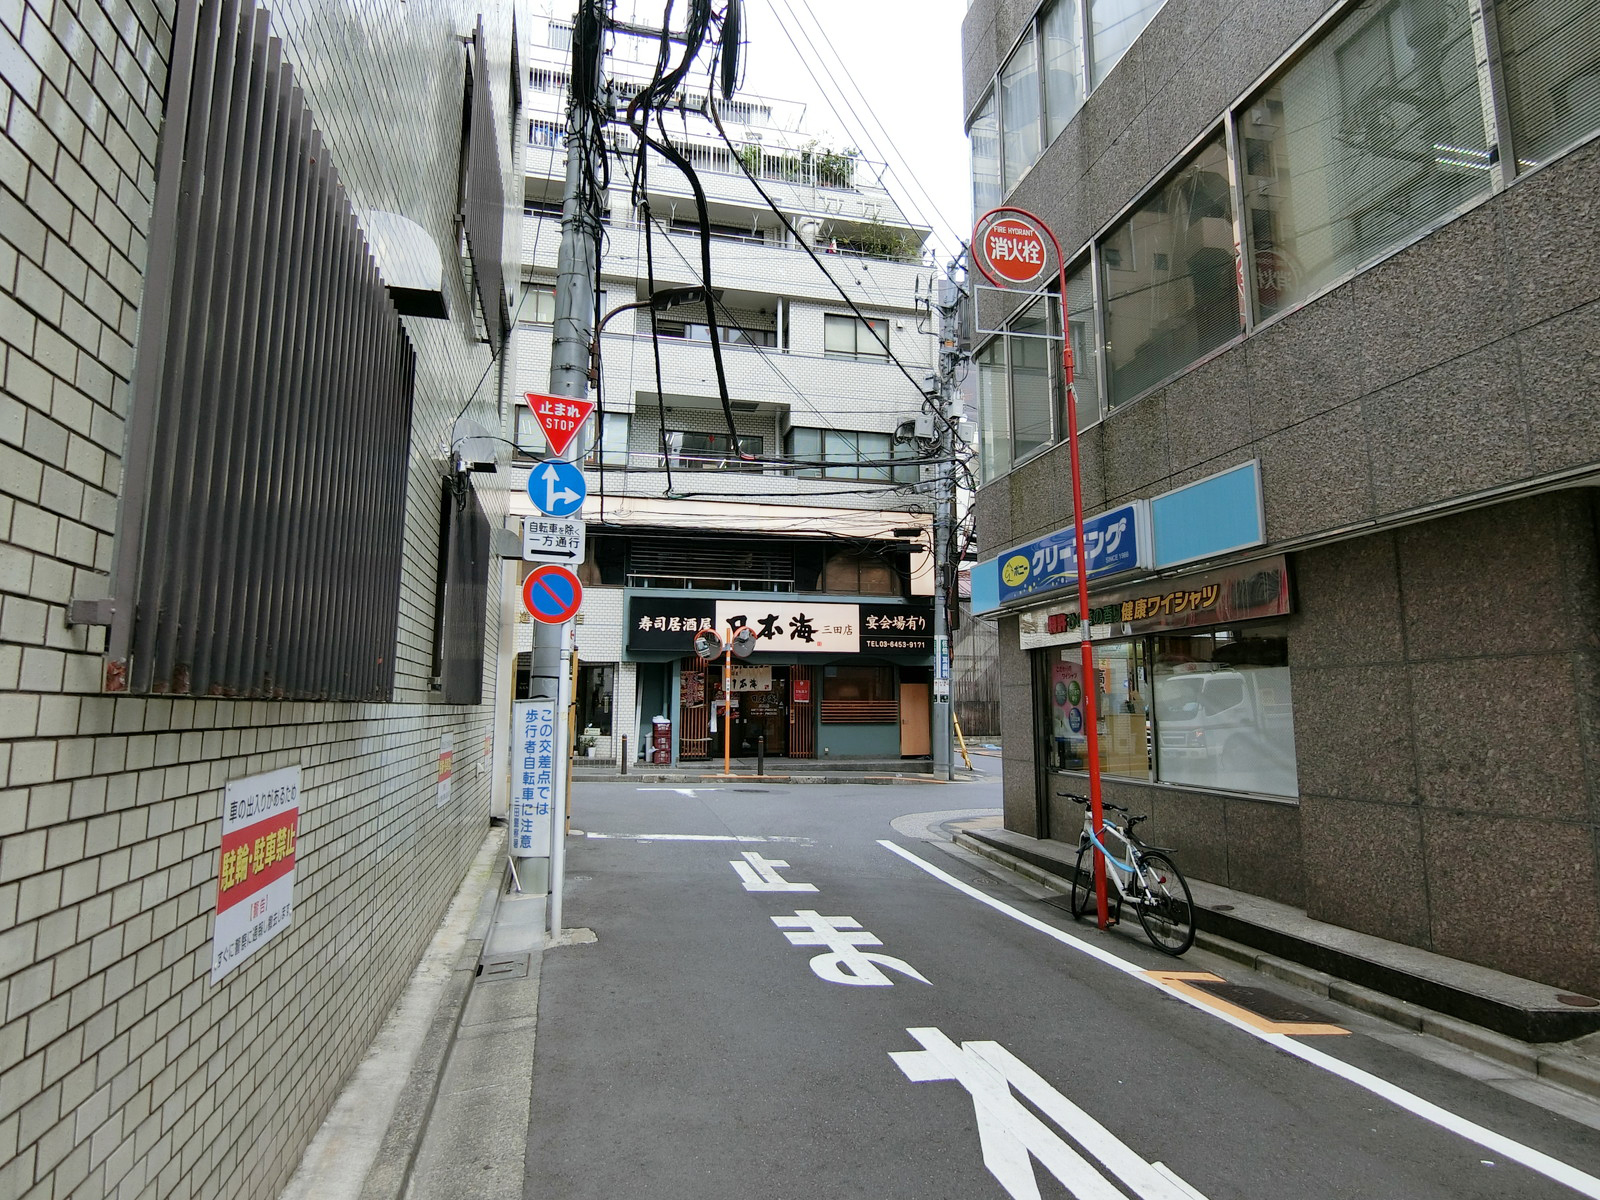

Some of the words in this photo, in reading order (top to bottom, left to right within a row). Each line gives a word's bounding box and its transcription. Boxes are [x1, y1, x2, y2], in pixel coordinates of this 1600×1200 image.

[993, 226, 1006, 234] FIRE
[1008, 227, 1033, 237] HYDRANT
[990, 236, 1041, 264] 消火栓
[539, 401, 580, 418] 止まれ
[546, 418, 575, 431] STOP
[529, 521, 580, 536] 自転車を除く
[529, 535, 580, 549] 一方通行
[1031, 517, 1127, 576] クリーニング
[638, 615, 712, 632] 寿司居酒屋
[821, 624, 853, 636] 三田店
[865, 614, 926, 631] 宴会場有り
[536, 709, 552, 815] この交差点では
[520, 709, 538, 849] 歩行者自転車に注意
[229, 785, 297, 823] 車の出入りがあるため
[220, 823, 295, 892] 駐輪・駐車禁止
